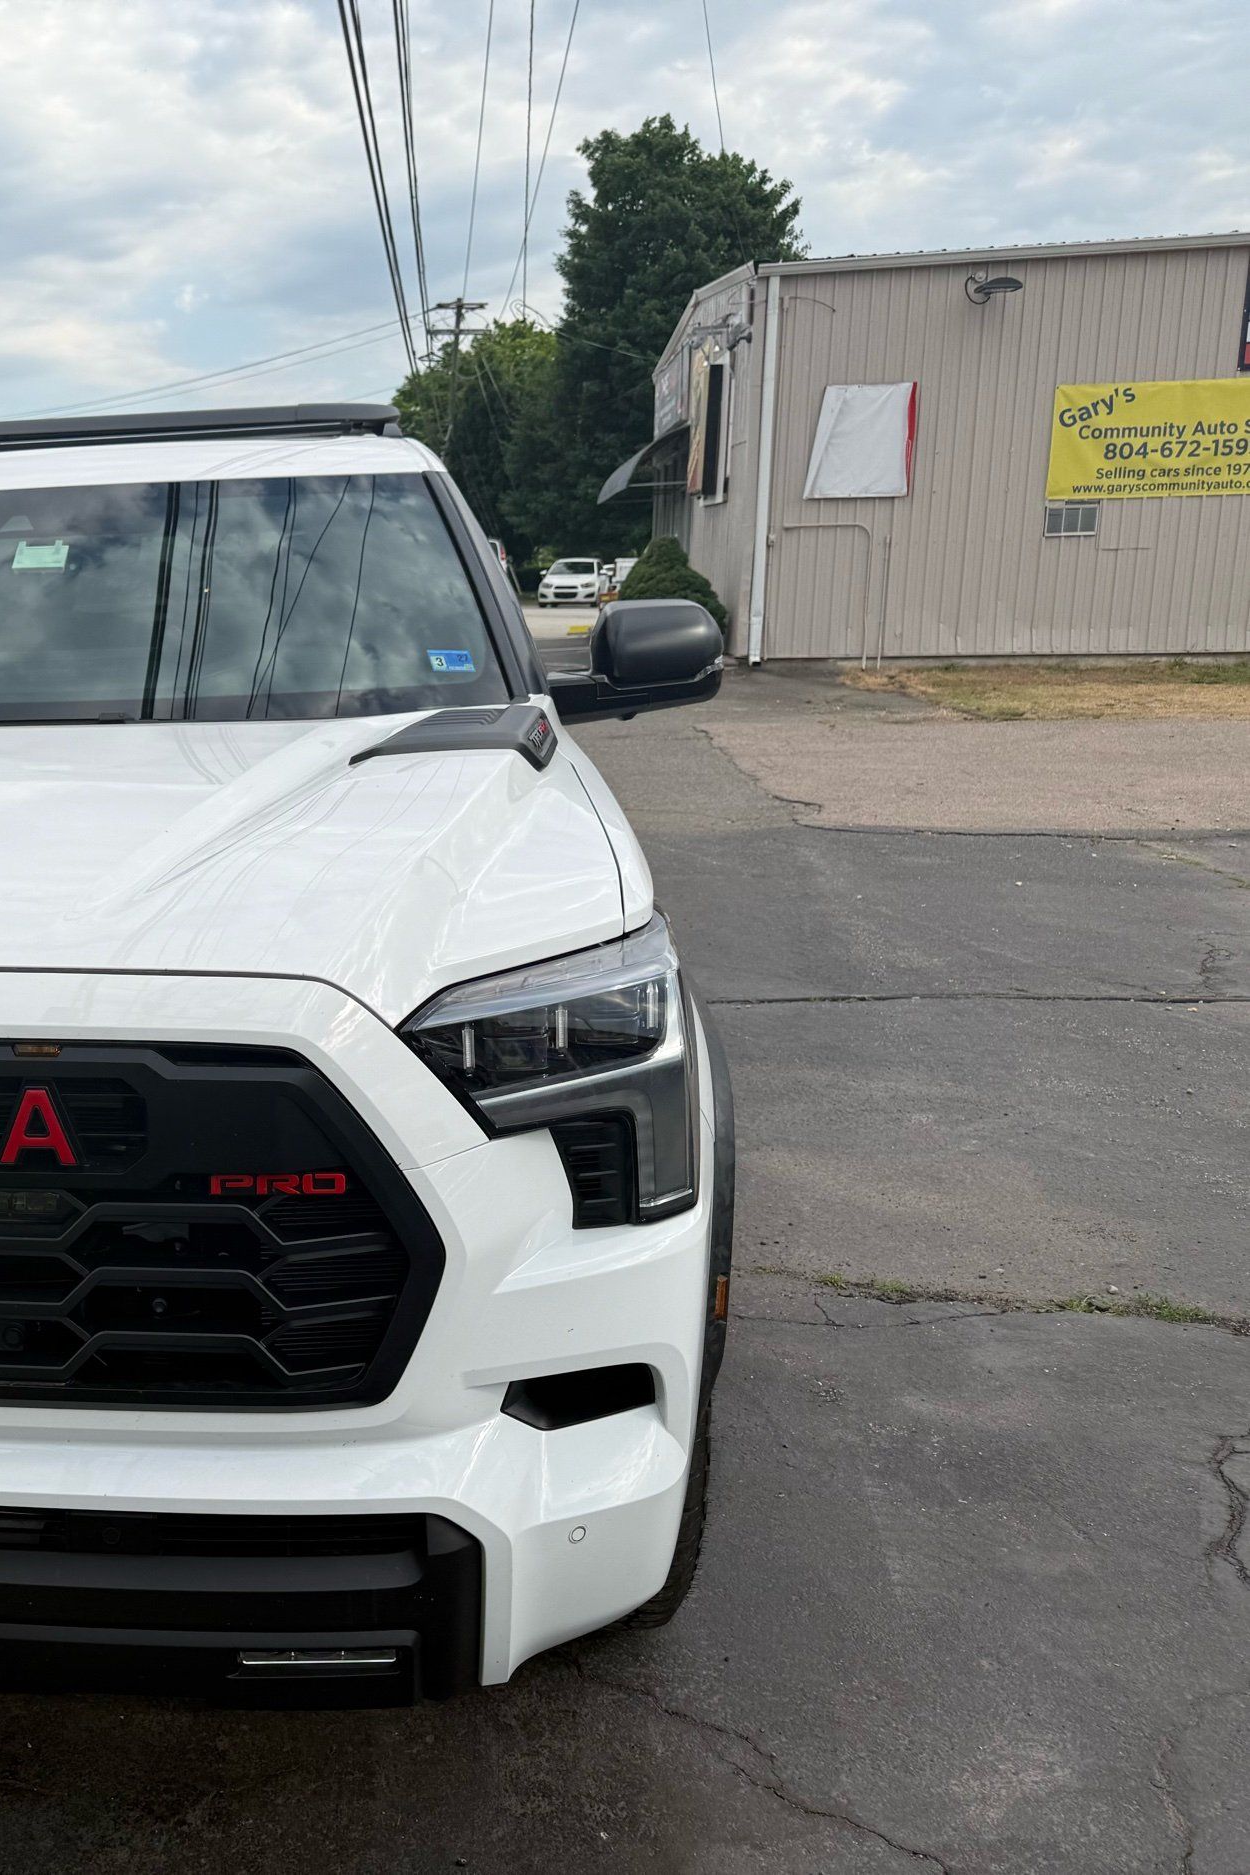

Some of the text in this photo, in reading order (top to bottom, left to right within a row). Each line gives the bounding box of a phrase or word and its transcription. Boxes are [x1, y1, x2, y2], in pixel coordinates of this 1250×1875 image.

[1058, 387, 1136, 428] Gary's
[1078, 422, 1187, 440] Community
[1191, 420, 1239, 436] Auto
[1103, 438, 1250, 460] 804-672-159
[1096, 467, 1146, 480] Selling
[1150, 466, 1180, 478] cars
[1183, 464, 1222, 477] since
[435, 657, 444, 667] 3
[210, 1173, 346, 1195] PRO
